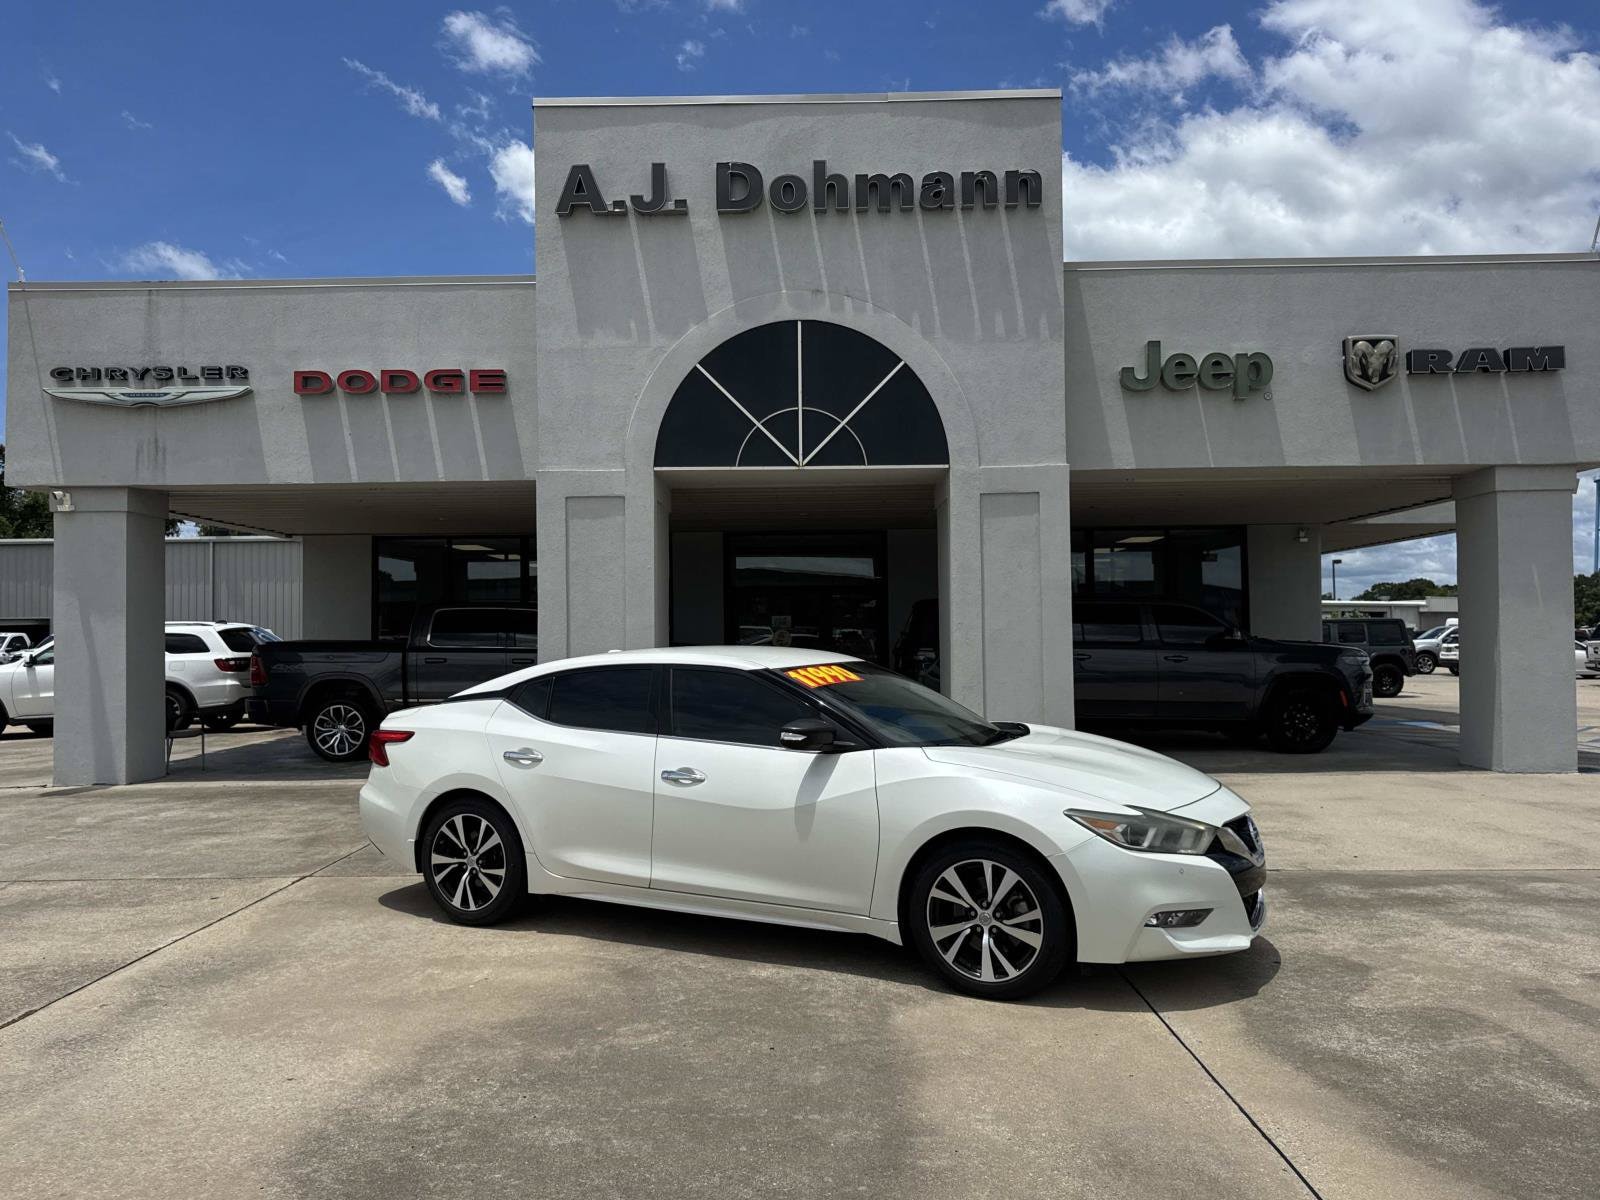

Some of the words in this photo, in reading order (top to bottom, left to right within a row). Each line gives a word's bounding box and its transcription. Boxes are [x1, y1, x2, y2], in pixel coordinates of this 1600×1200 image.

[555, 163, 688, 215] A.J.
[715, 160, 1042, 214] Dohmann
[49, 365, 249, 382] CHRYSLER
[1120, 340, 1274, 399] Jeep
[1406, 345, 1566, 376] RAM
[293, 369, 506, 394] DODGE
